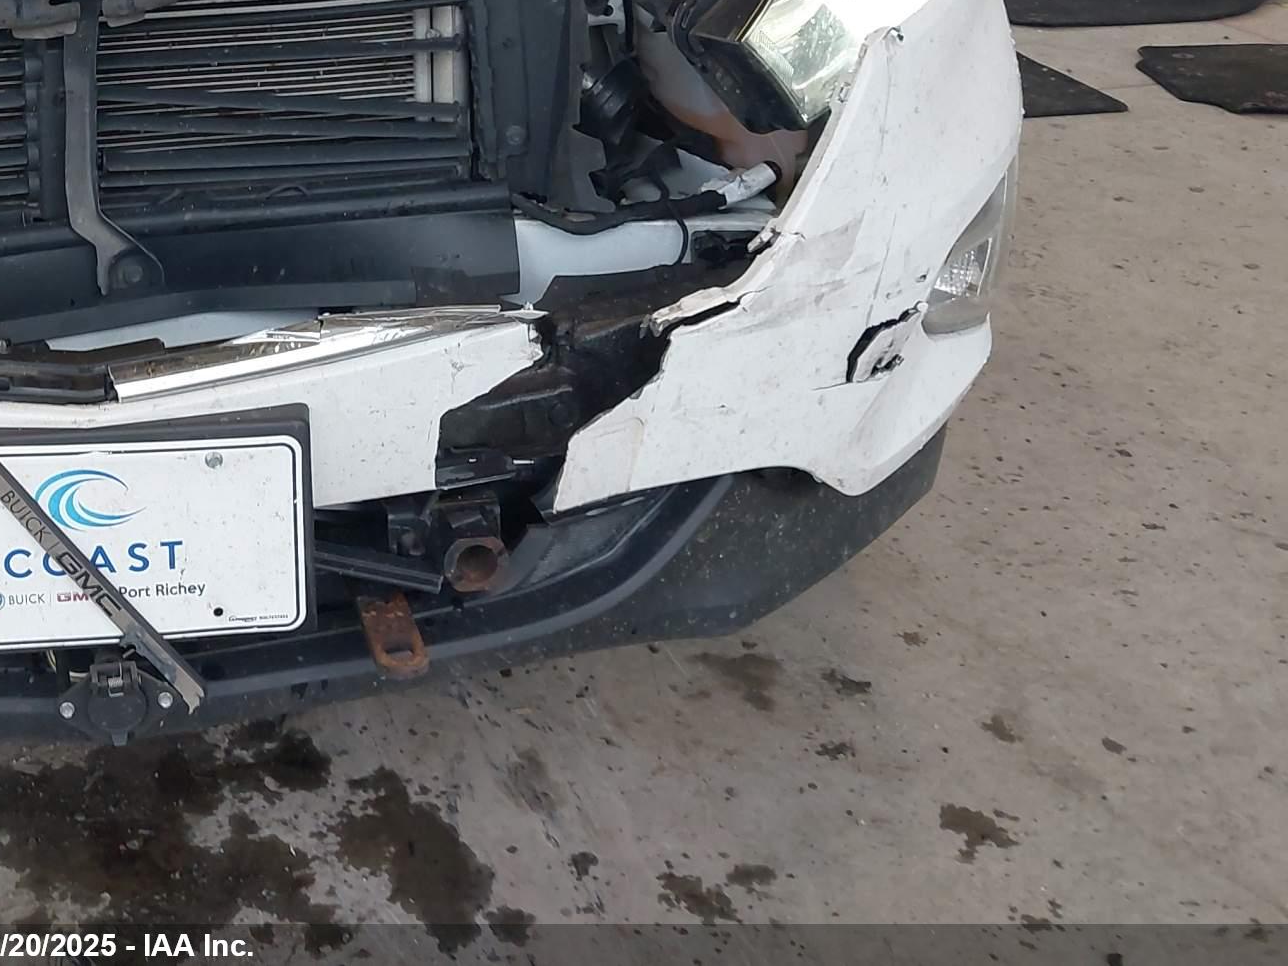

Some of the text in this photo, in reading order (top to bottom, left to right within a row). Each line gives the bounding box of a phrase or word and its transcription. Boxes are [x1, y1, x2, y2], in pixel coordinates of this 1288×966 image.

[0, 490, 122, 617] BUICK GMC
[119, 582, 207, 598] Port Richey
[8, 592, 89, 605] BUICK GM
